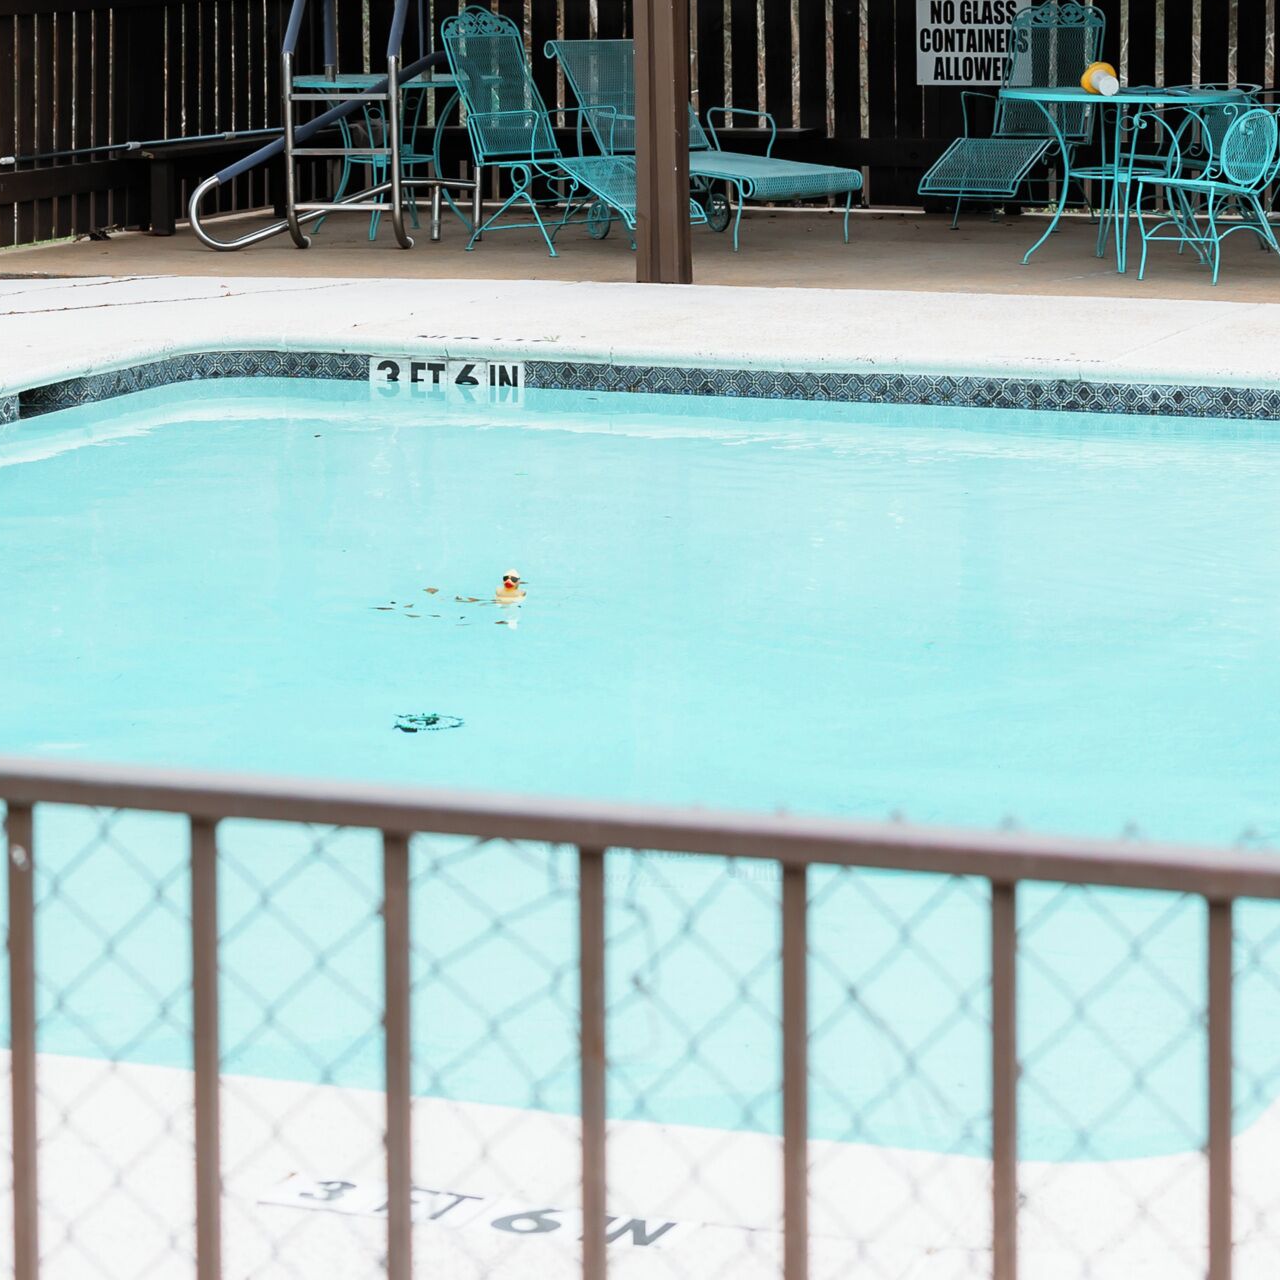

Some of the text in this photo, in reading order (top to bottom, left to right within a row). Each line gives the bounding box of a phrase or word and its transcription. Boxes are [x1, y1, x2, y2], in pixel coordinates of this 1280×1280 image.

[930, 0, 1017, 25] NO GLASS
[920, 28, 1029, 53] CONTAINERS
[933, 57, 1014, 81] ALLOWED
[377, 360, 518, 387] 3 FT 6 IN
[298, 1181, 356, 1202] 3
[491, 1209, 561, 1234] 6
